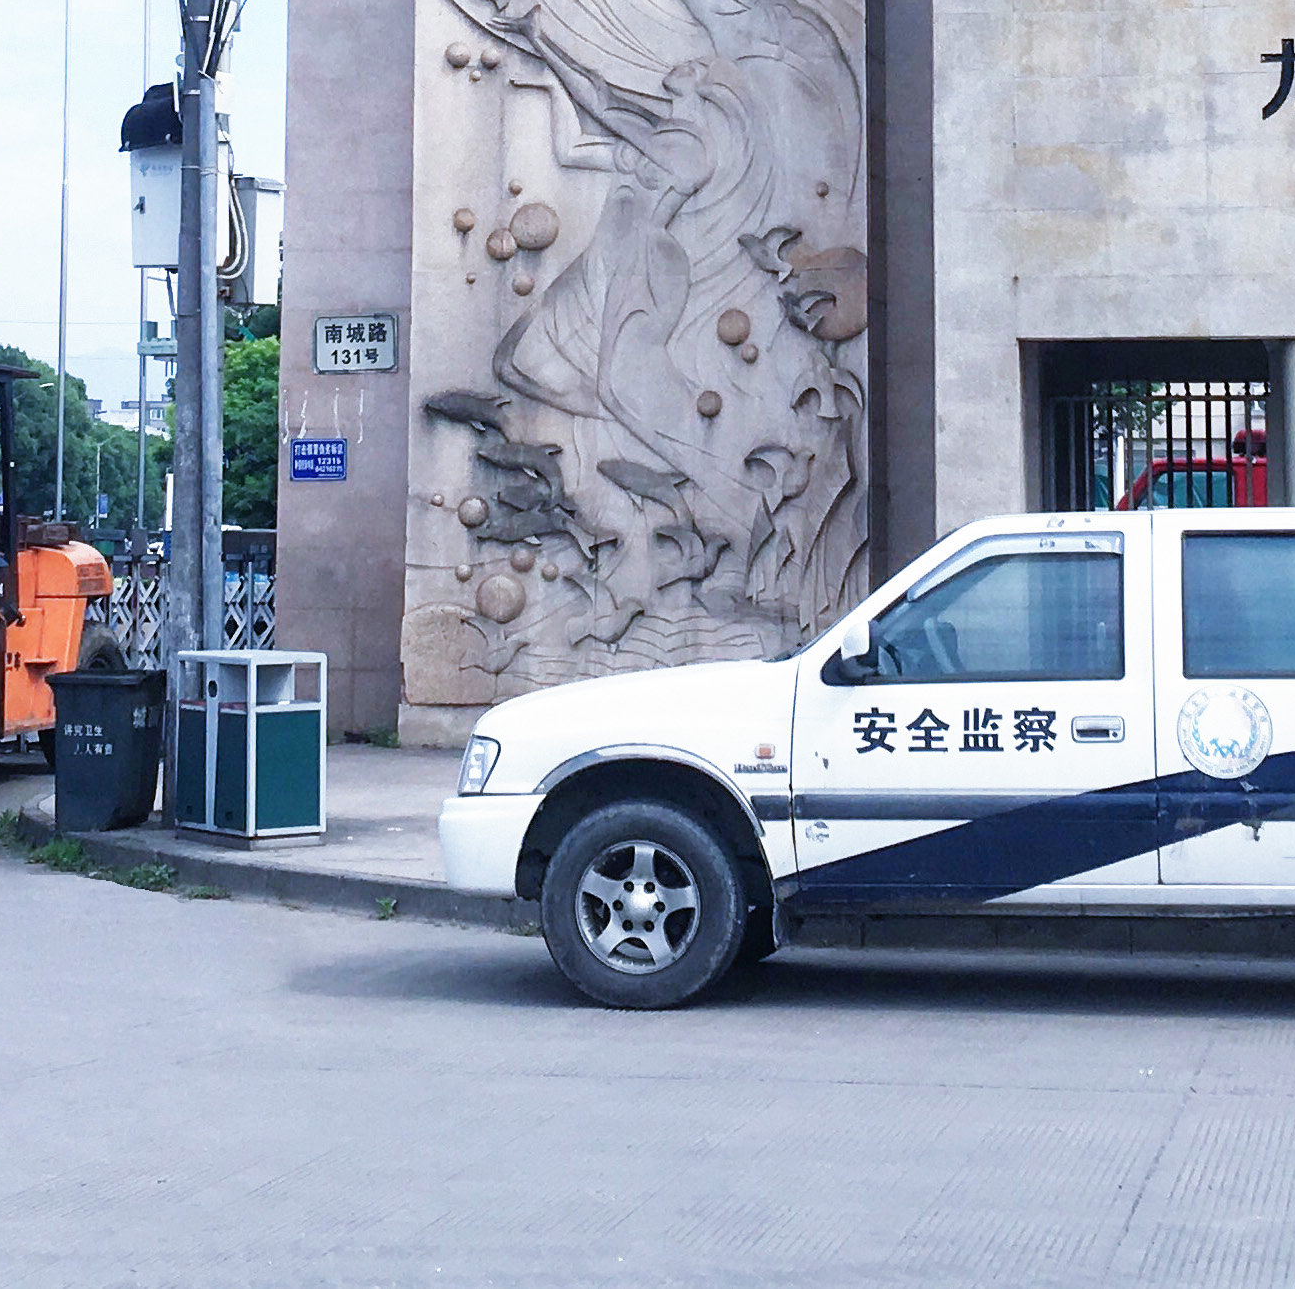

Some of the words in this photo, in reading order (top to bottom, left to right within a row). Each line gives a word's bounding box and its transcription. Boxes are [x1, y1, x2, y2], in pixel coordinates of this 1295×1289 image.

[325, 323, 387, 344] 南城路
[331, 348, 379, 365] 131号
[64, 724, 103, 737] 讲究卫生
[853, 707, 1058, 754] 安全监察
